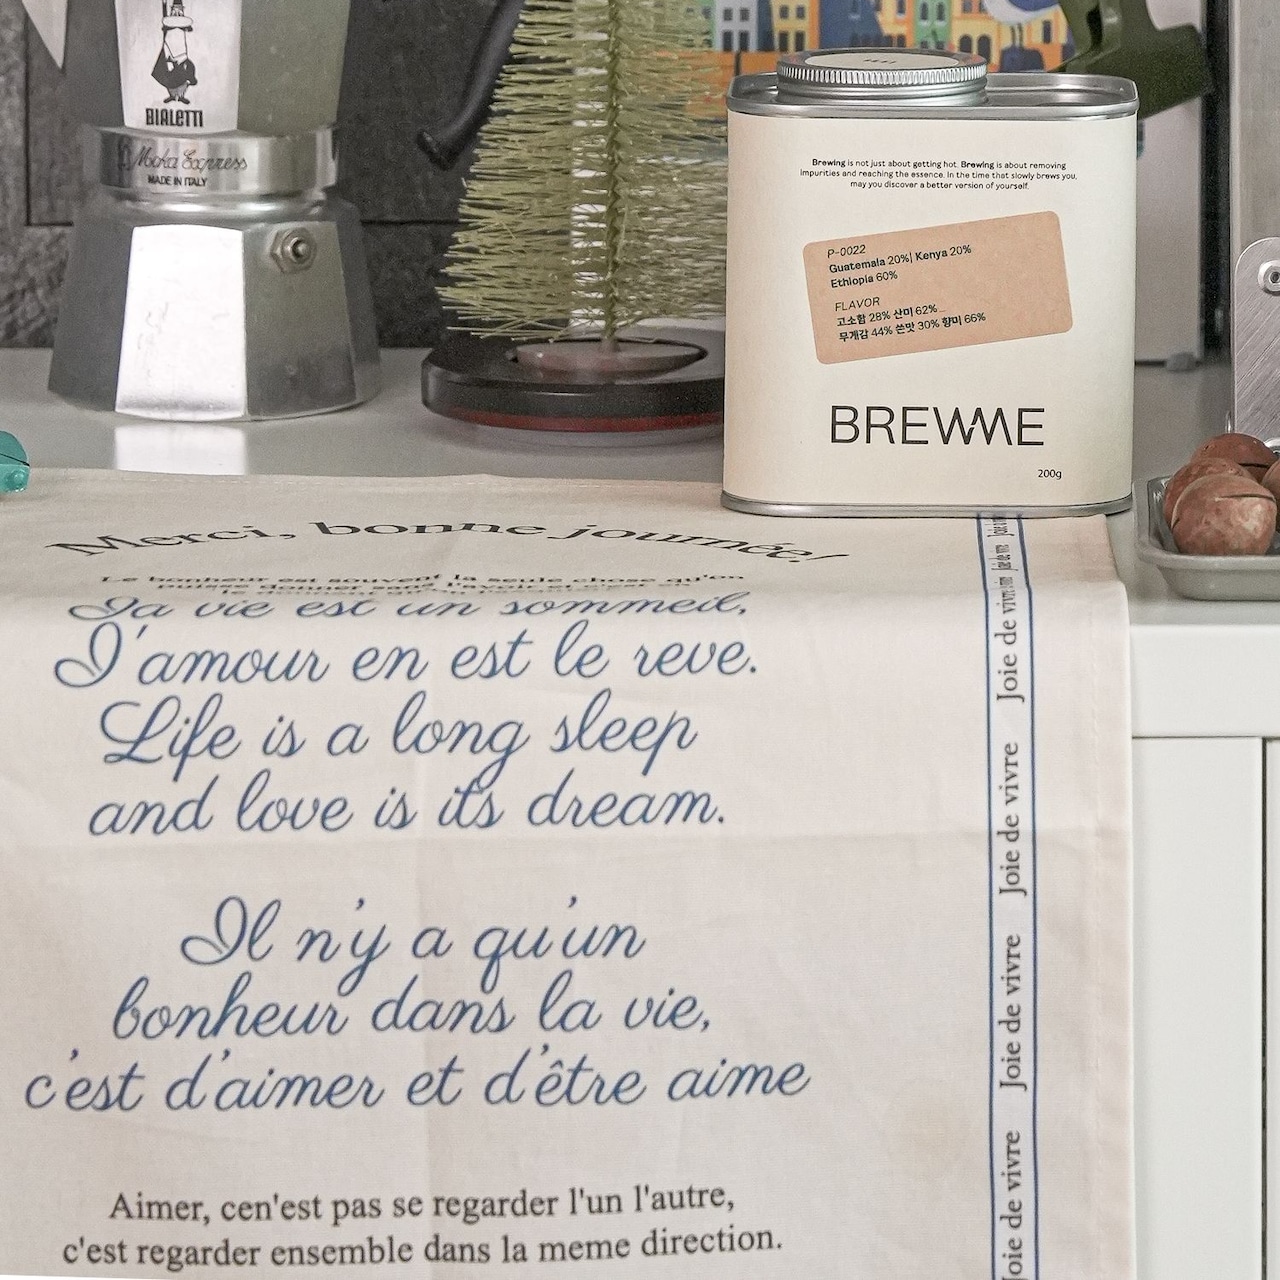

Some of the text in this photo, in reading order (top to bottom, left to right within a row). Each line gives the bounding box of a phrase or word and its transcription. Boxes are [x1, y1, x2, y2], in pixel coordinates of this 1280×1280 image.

[145, 108, 204, 128] BIALETTI
[182, 149, 248, 174] Express
[812, 158, 846, 168] Brewing
[870, 160, 886, 168] just
[888, 160, 911, 168] about
[912, 160, 942, 169] getting
[960, 161, 994, 170] Brewing
[1030, 162, 1066, 170] removing
[858, 170, 894, 178] reaching
[896, 170, 908, 178] the
[1011, 172, 1034, 180] slowly
[1036, 172, 1060, 180] brews
[148, 174, 208, 187] MADE IN ITALY
[828, 244, 866, 259] P-0022
[829, 258, 886, 274] Guatemala
[915, 250, 948, 262] Kenya
[950, 244, 972, 257] 20%
[830, 270, 898, 288] Ethiopia 60%
[835, 296, 880, 312] FLAVOR
[836, 304, 938, 327] 고소함 28% 산미 62%
[838, 312, 986, 342] 무게감 44% 쓴맛 30% 향미 66%
[1037, 469, 1062, 480] 200g
[45, 521, 850, 563] Merci, bonne journée!
[100, 688, 699, 792] Life is a long sleep
[89, 768, 726, 836] and love is its dream.
[996, 741, 1028, 898] Joie de vivre
[180, 896, 647, 997] Il n'y a qu'un
[113, 969, 711, 1040] bonheur dans la vie,
[25, 1043, 812, 1112] c'est d'aimer et d'être aime
[108, 1183, 735, 1227] Aimer, cen'est pas se regarder l'un l'autre,
[62, 1224, 784, 1272] c'est regarder ensemble dans la meme direction.
